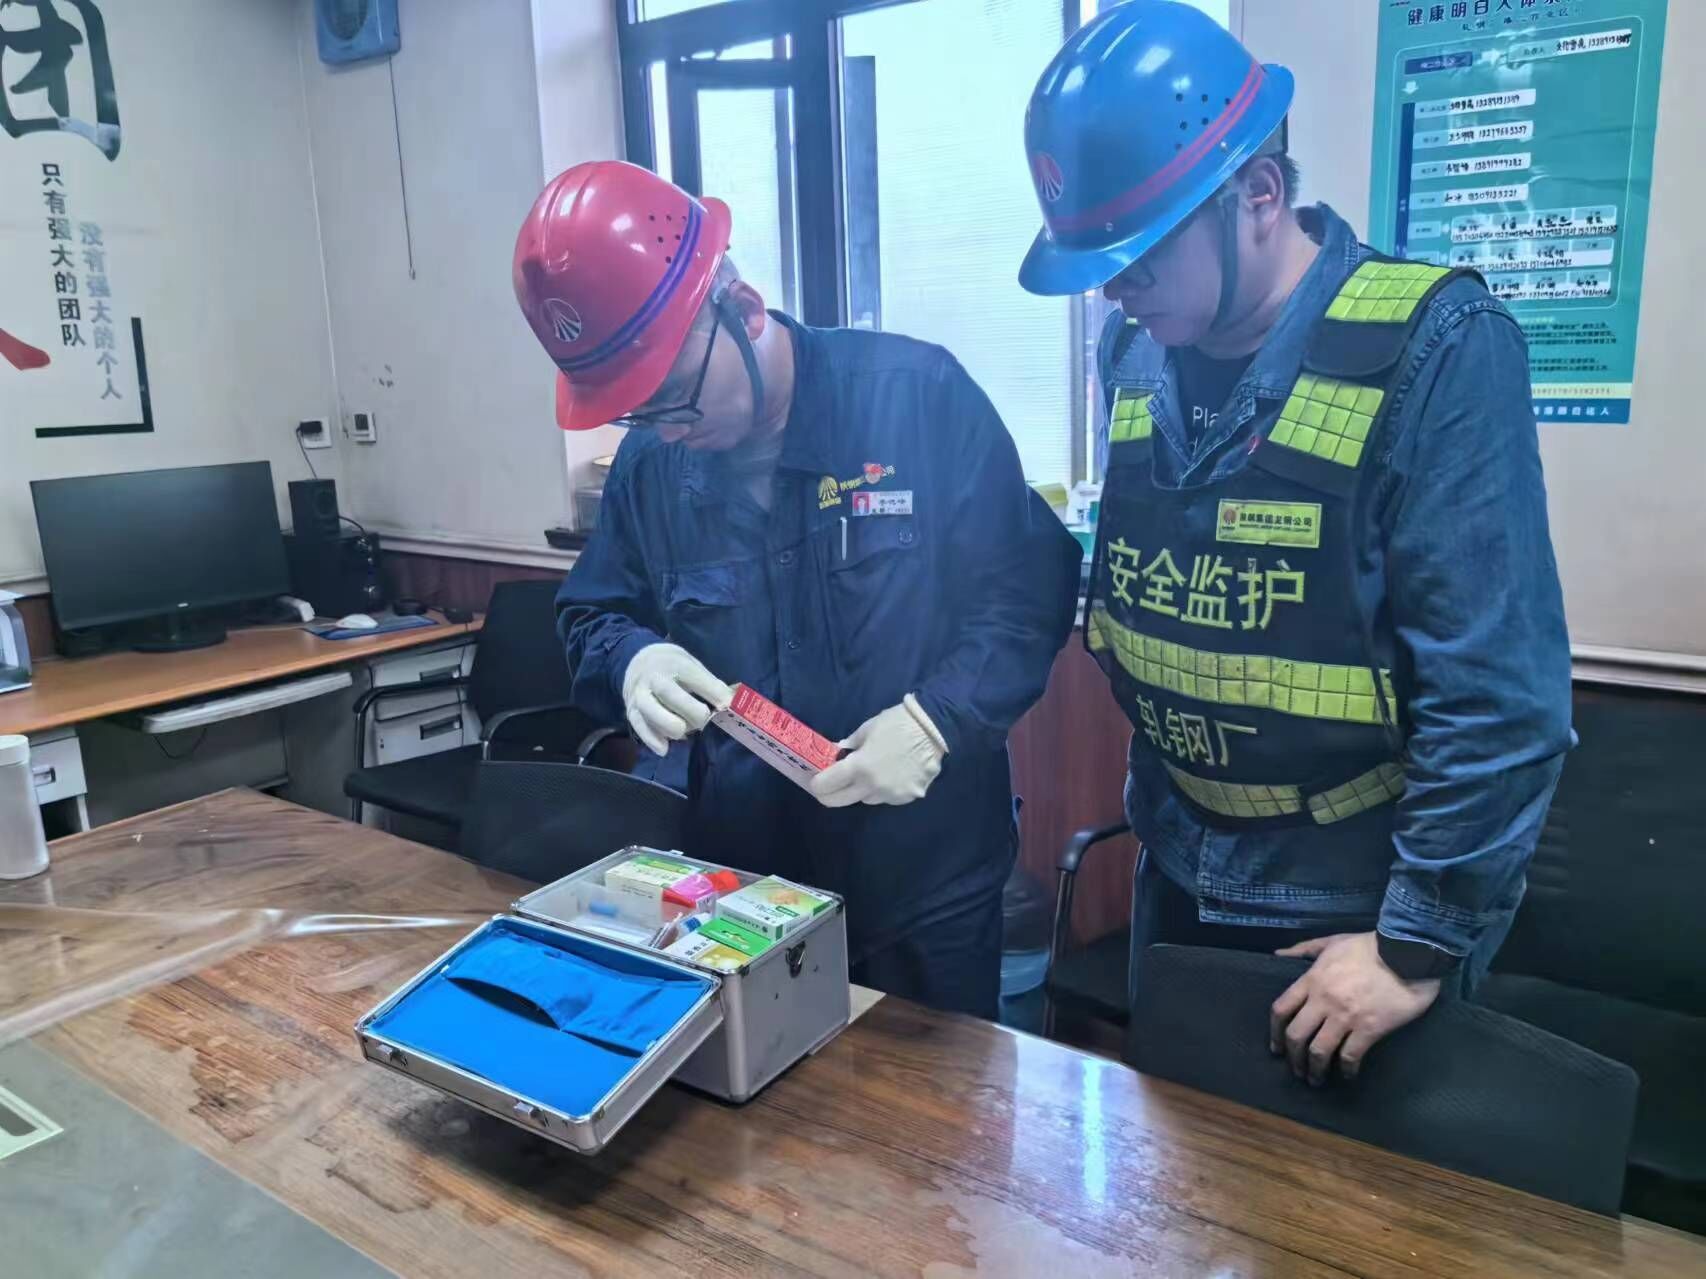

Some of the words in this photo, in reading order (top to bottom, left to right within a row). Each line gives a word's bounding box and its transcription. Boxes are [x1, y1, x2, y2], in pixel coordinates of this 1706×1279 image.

[0, 0, 122, 162] 团
[1407, 0, 1562, 25] 健康明白人
[42, 162, 87, 347] 只有强大的团队
[79, 221, 123, 401] 没有强大的个人
[1108, 537, 1305, 630] 安全监护
